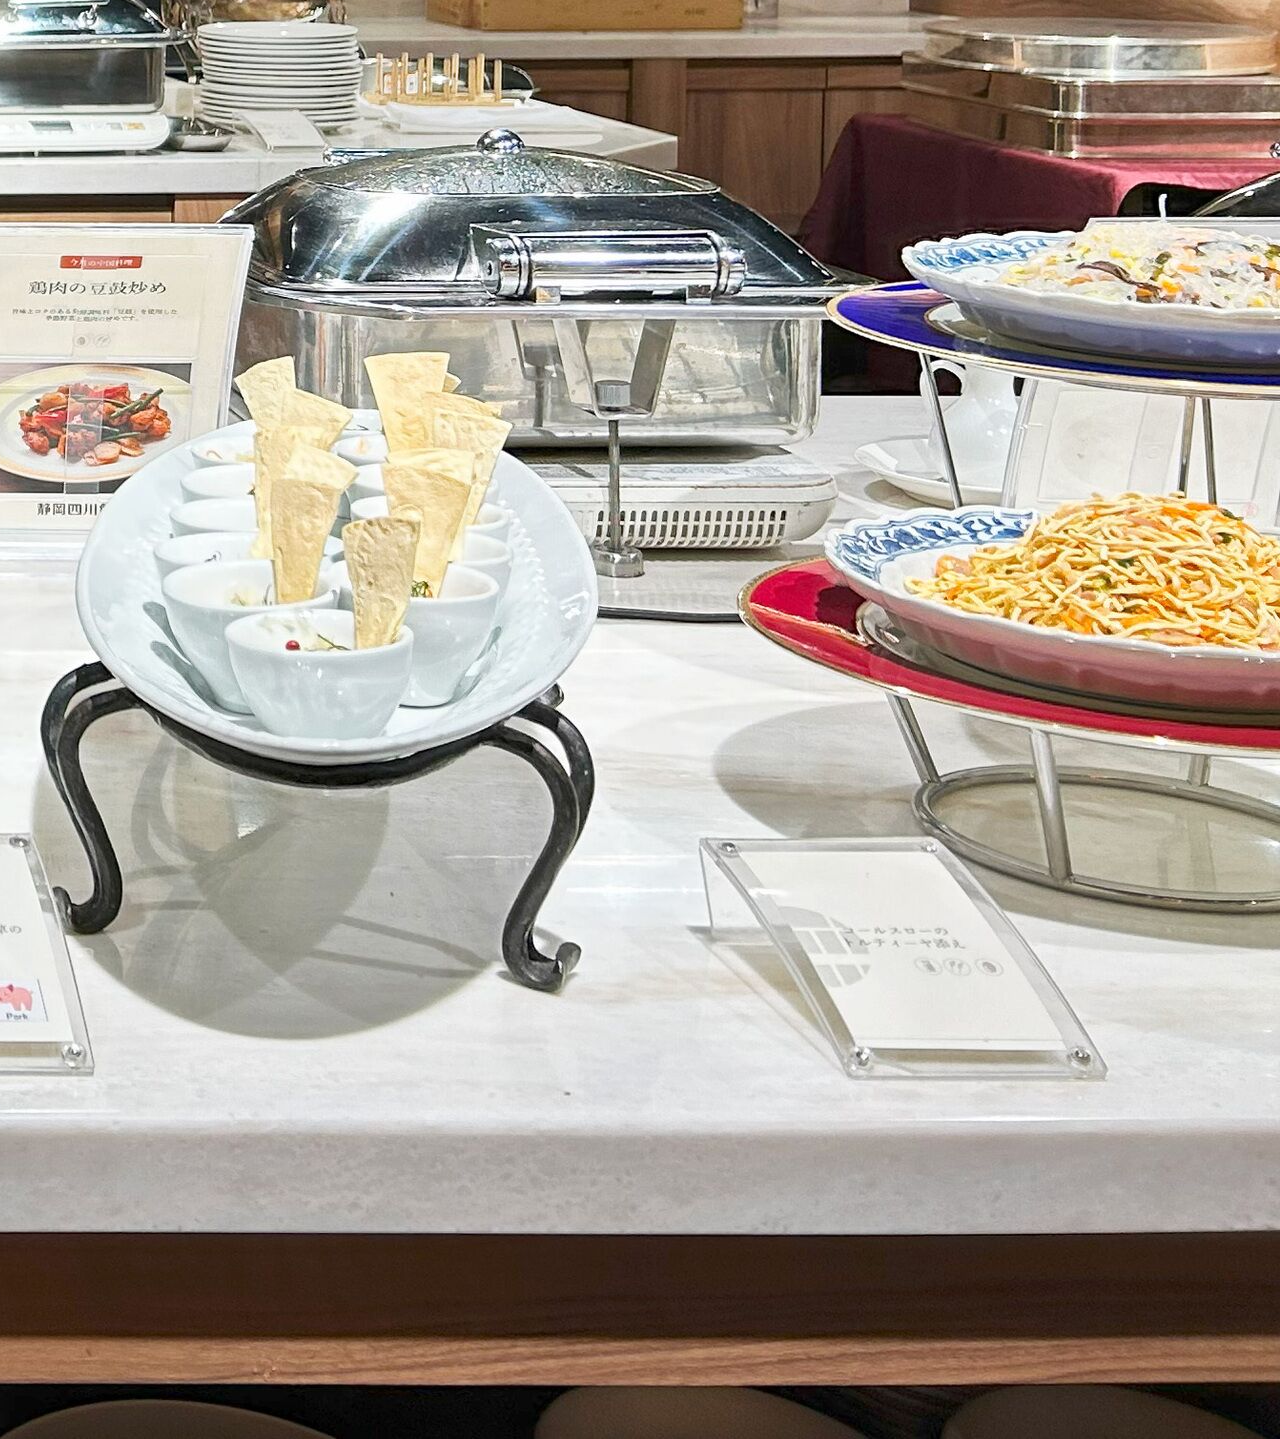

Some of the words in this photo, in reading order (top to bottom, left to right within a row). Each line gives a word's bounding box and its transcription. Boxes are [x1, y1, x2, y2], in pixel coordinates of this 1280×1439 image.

[841, 926, 950, 937] コールスローの
[843, 937, 967, 950] トルティーヤ添え
